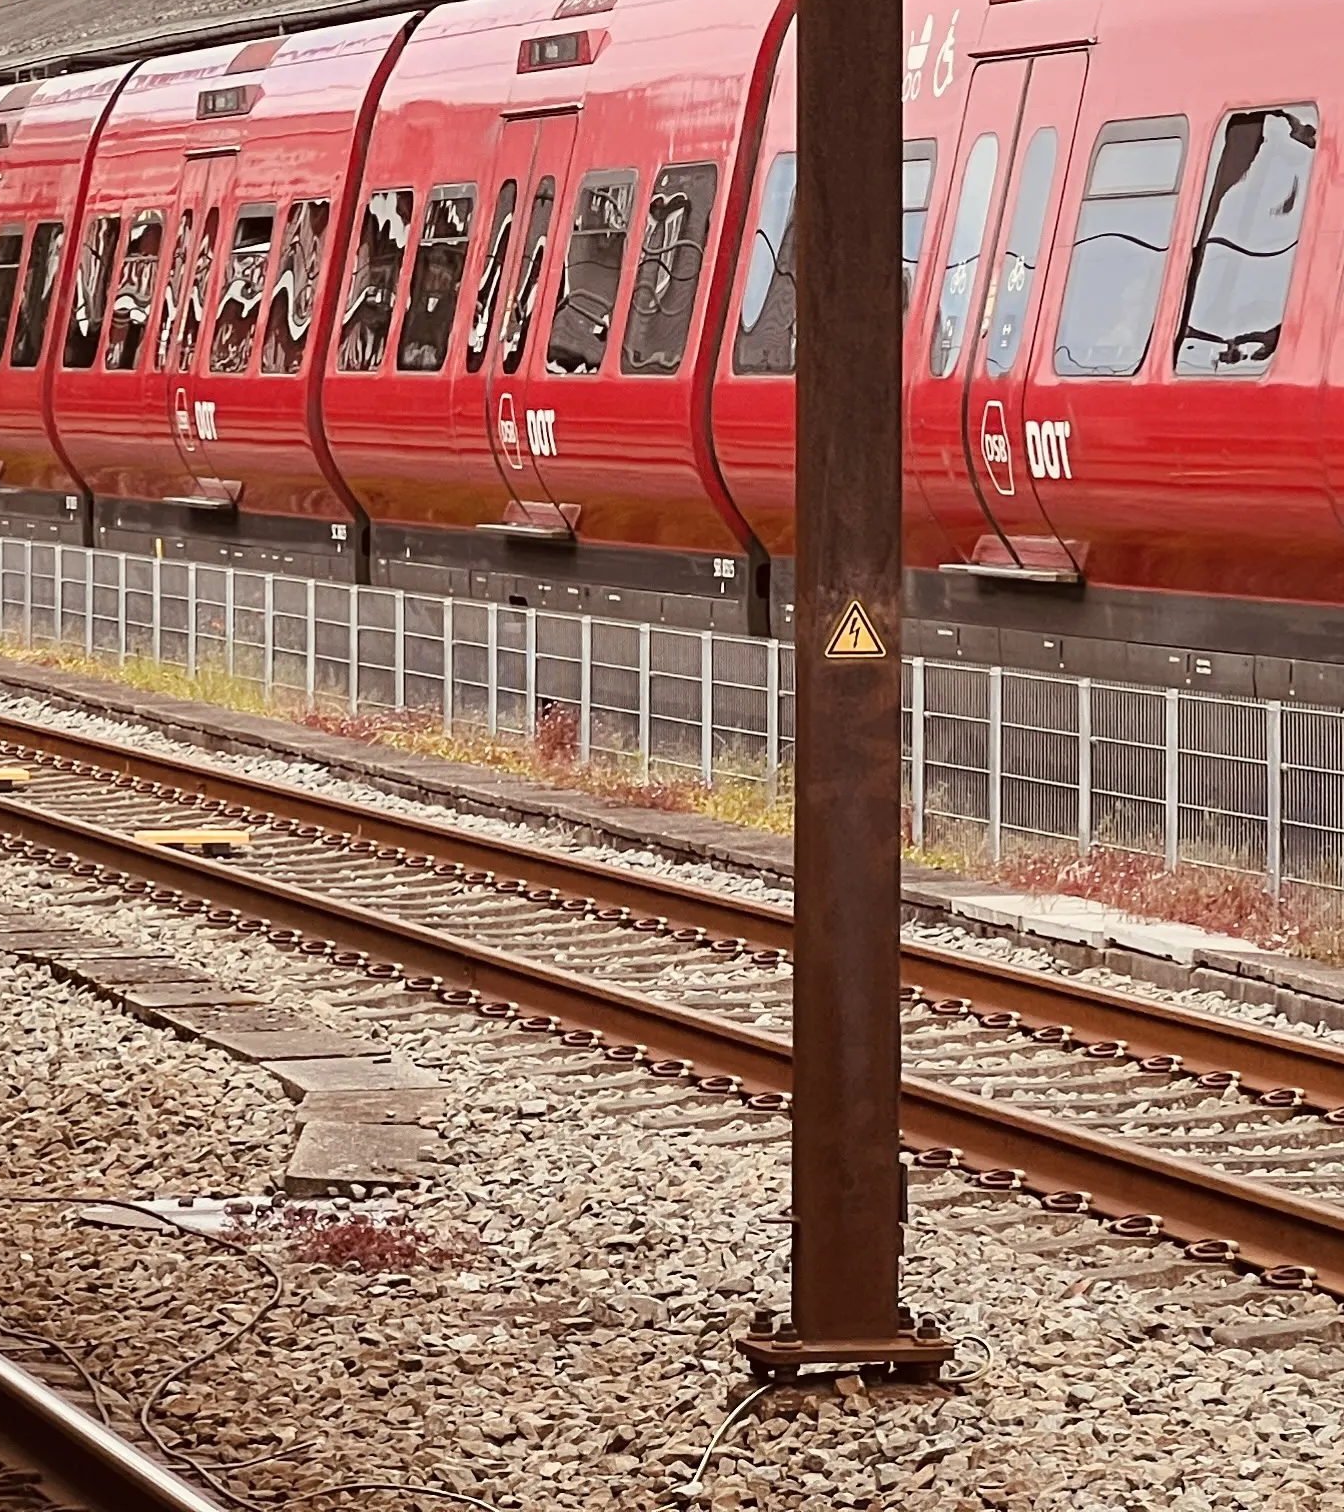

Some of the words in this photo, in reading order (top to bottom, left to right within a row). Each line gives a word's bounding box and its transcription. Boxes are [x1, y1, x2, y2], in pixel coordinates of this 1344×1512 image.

[526, 409, 557, 457] DOT
[984, 433, 1008, 463] DSB
[1025, 420, 1072, 479] DOT
